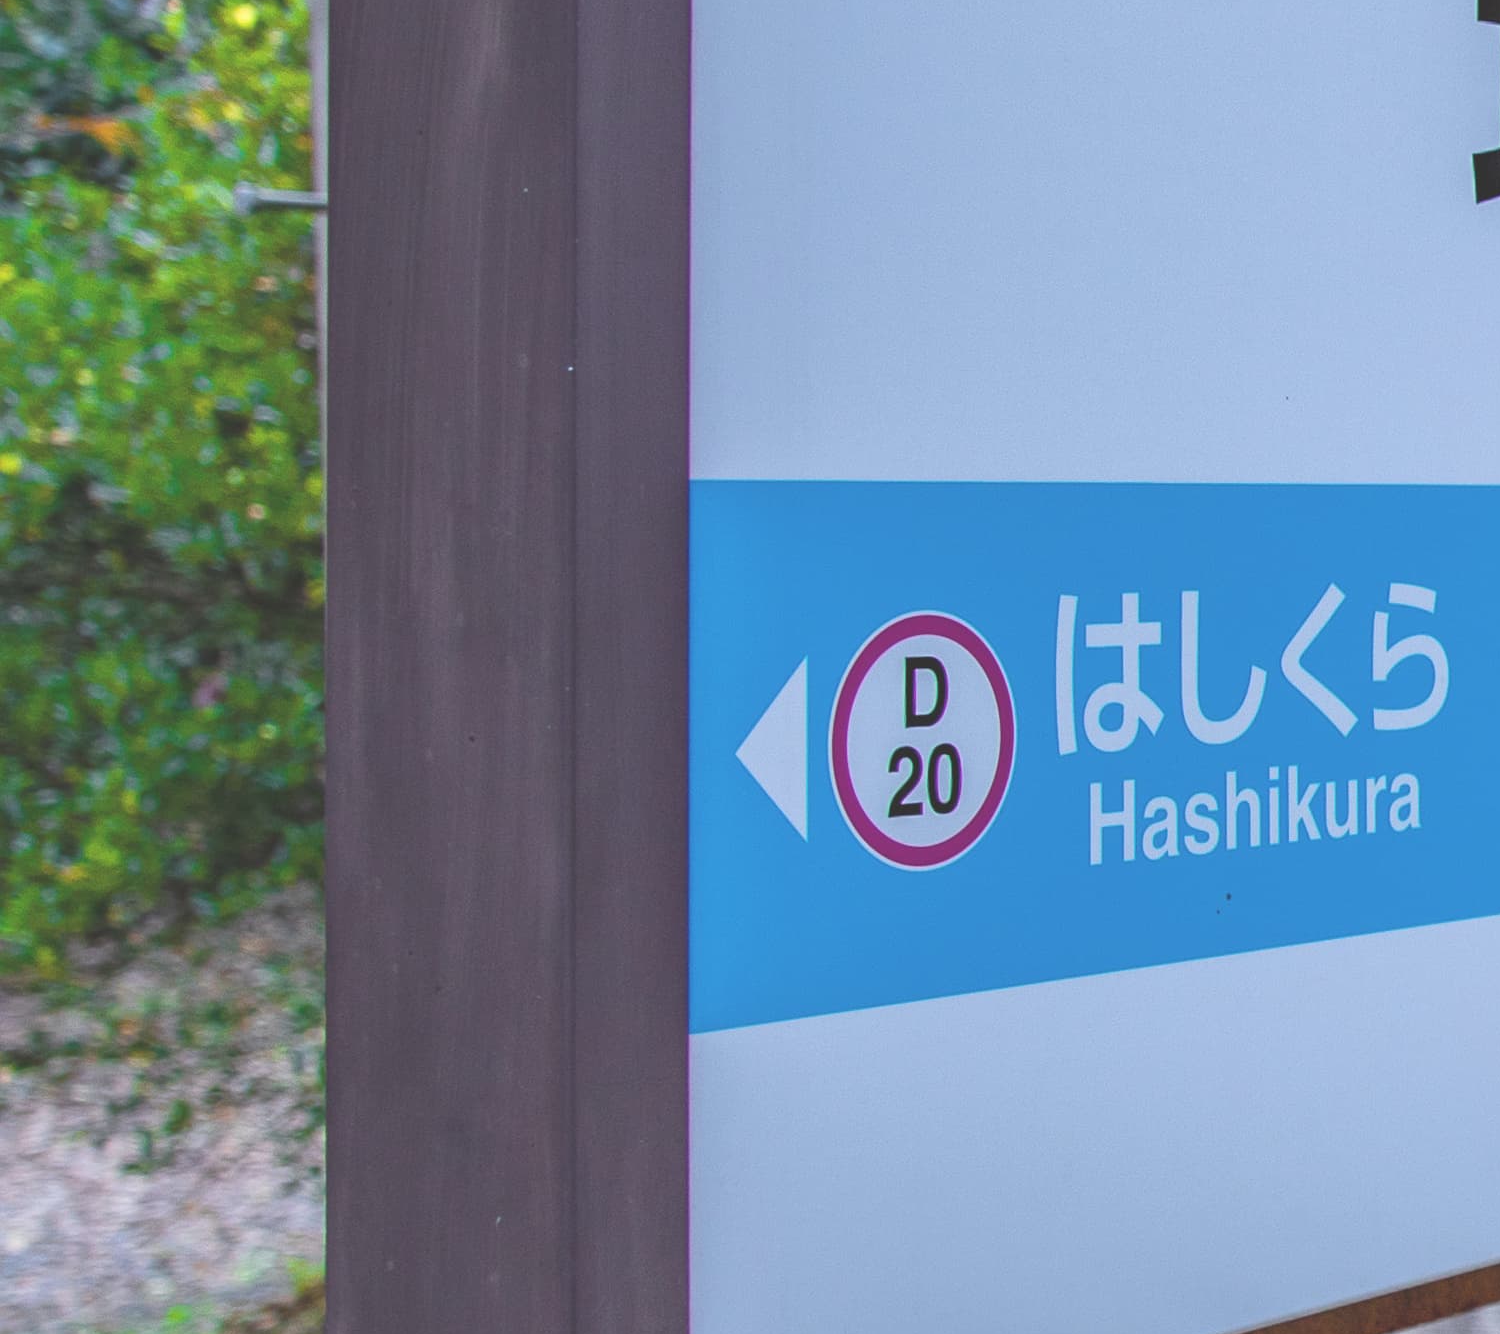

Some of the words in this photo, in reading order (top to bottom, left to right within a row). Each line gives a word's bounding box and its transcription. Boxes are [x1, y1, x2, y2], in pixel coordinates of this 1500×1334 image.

[903, 655, 950, 730] D
[1054, 581, 1451, 757] はしくら
[886, 741, 963, 820] 20
[1088, 760, 1422, 867] Hashikura
